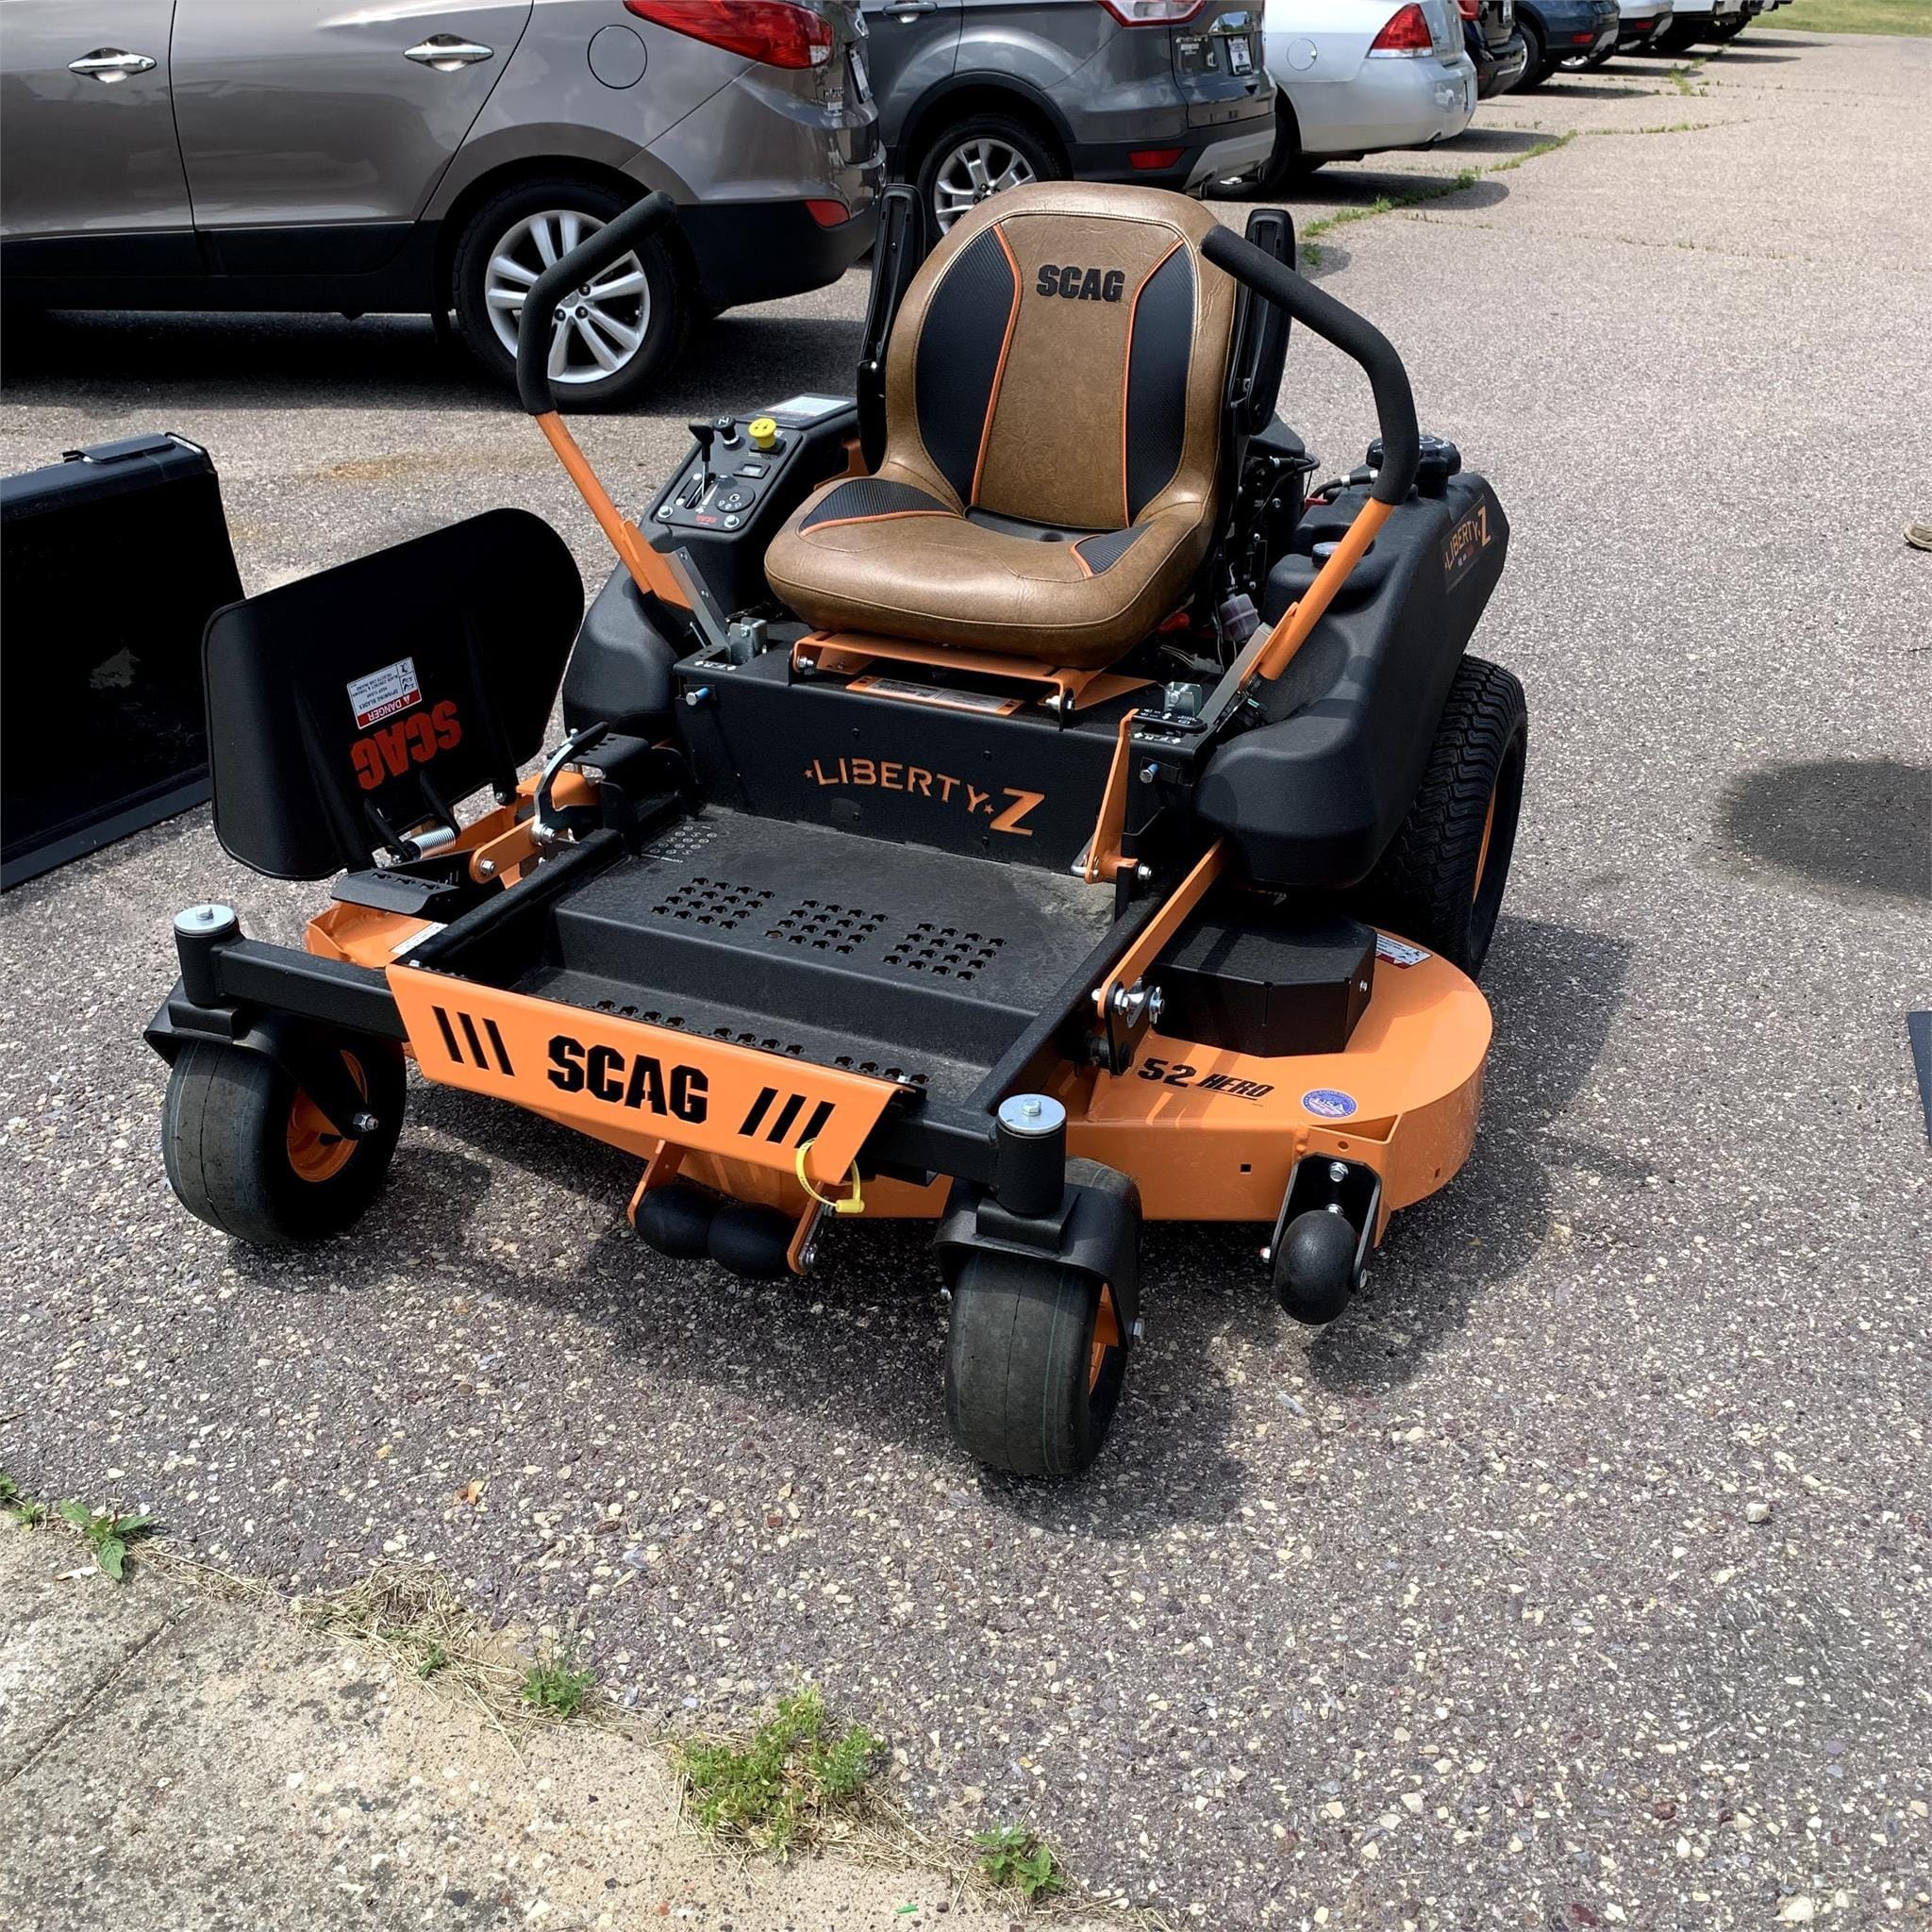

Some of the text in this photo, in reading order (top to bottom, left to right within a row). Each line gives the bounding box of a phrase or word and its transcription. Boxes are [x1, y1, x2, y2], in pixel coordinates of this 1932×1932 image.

[1036, 264, 1125, 302] SCAG
[1447, 520, 1479, 570] LIBERTY
[1477, 506, 1491, 547] Z
[358, 697, 376, 710] BLADES
[367, 699, 402, 722] DANGER
[351, 700, 462, 791] SCAG
[813, 758, 1045, 837] LIBERTY Z
[547, 1034, 709, 1124] SCAG
[1138, 1057, 1274, 1097] 52 HERO
